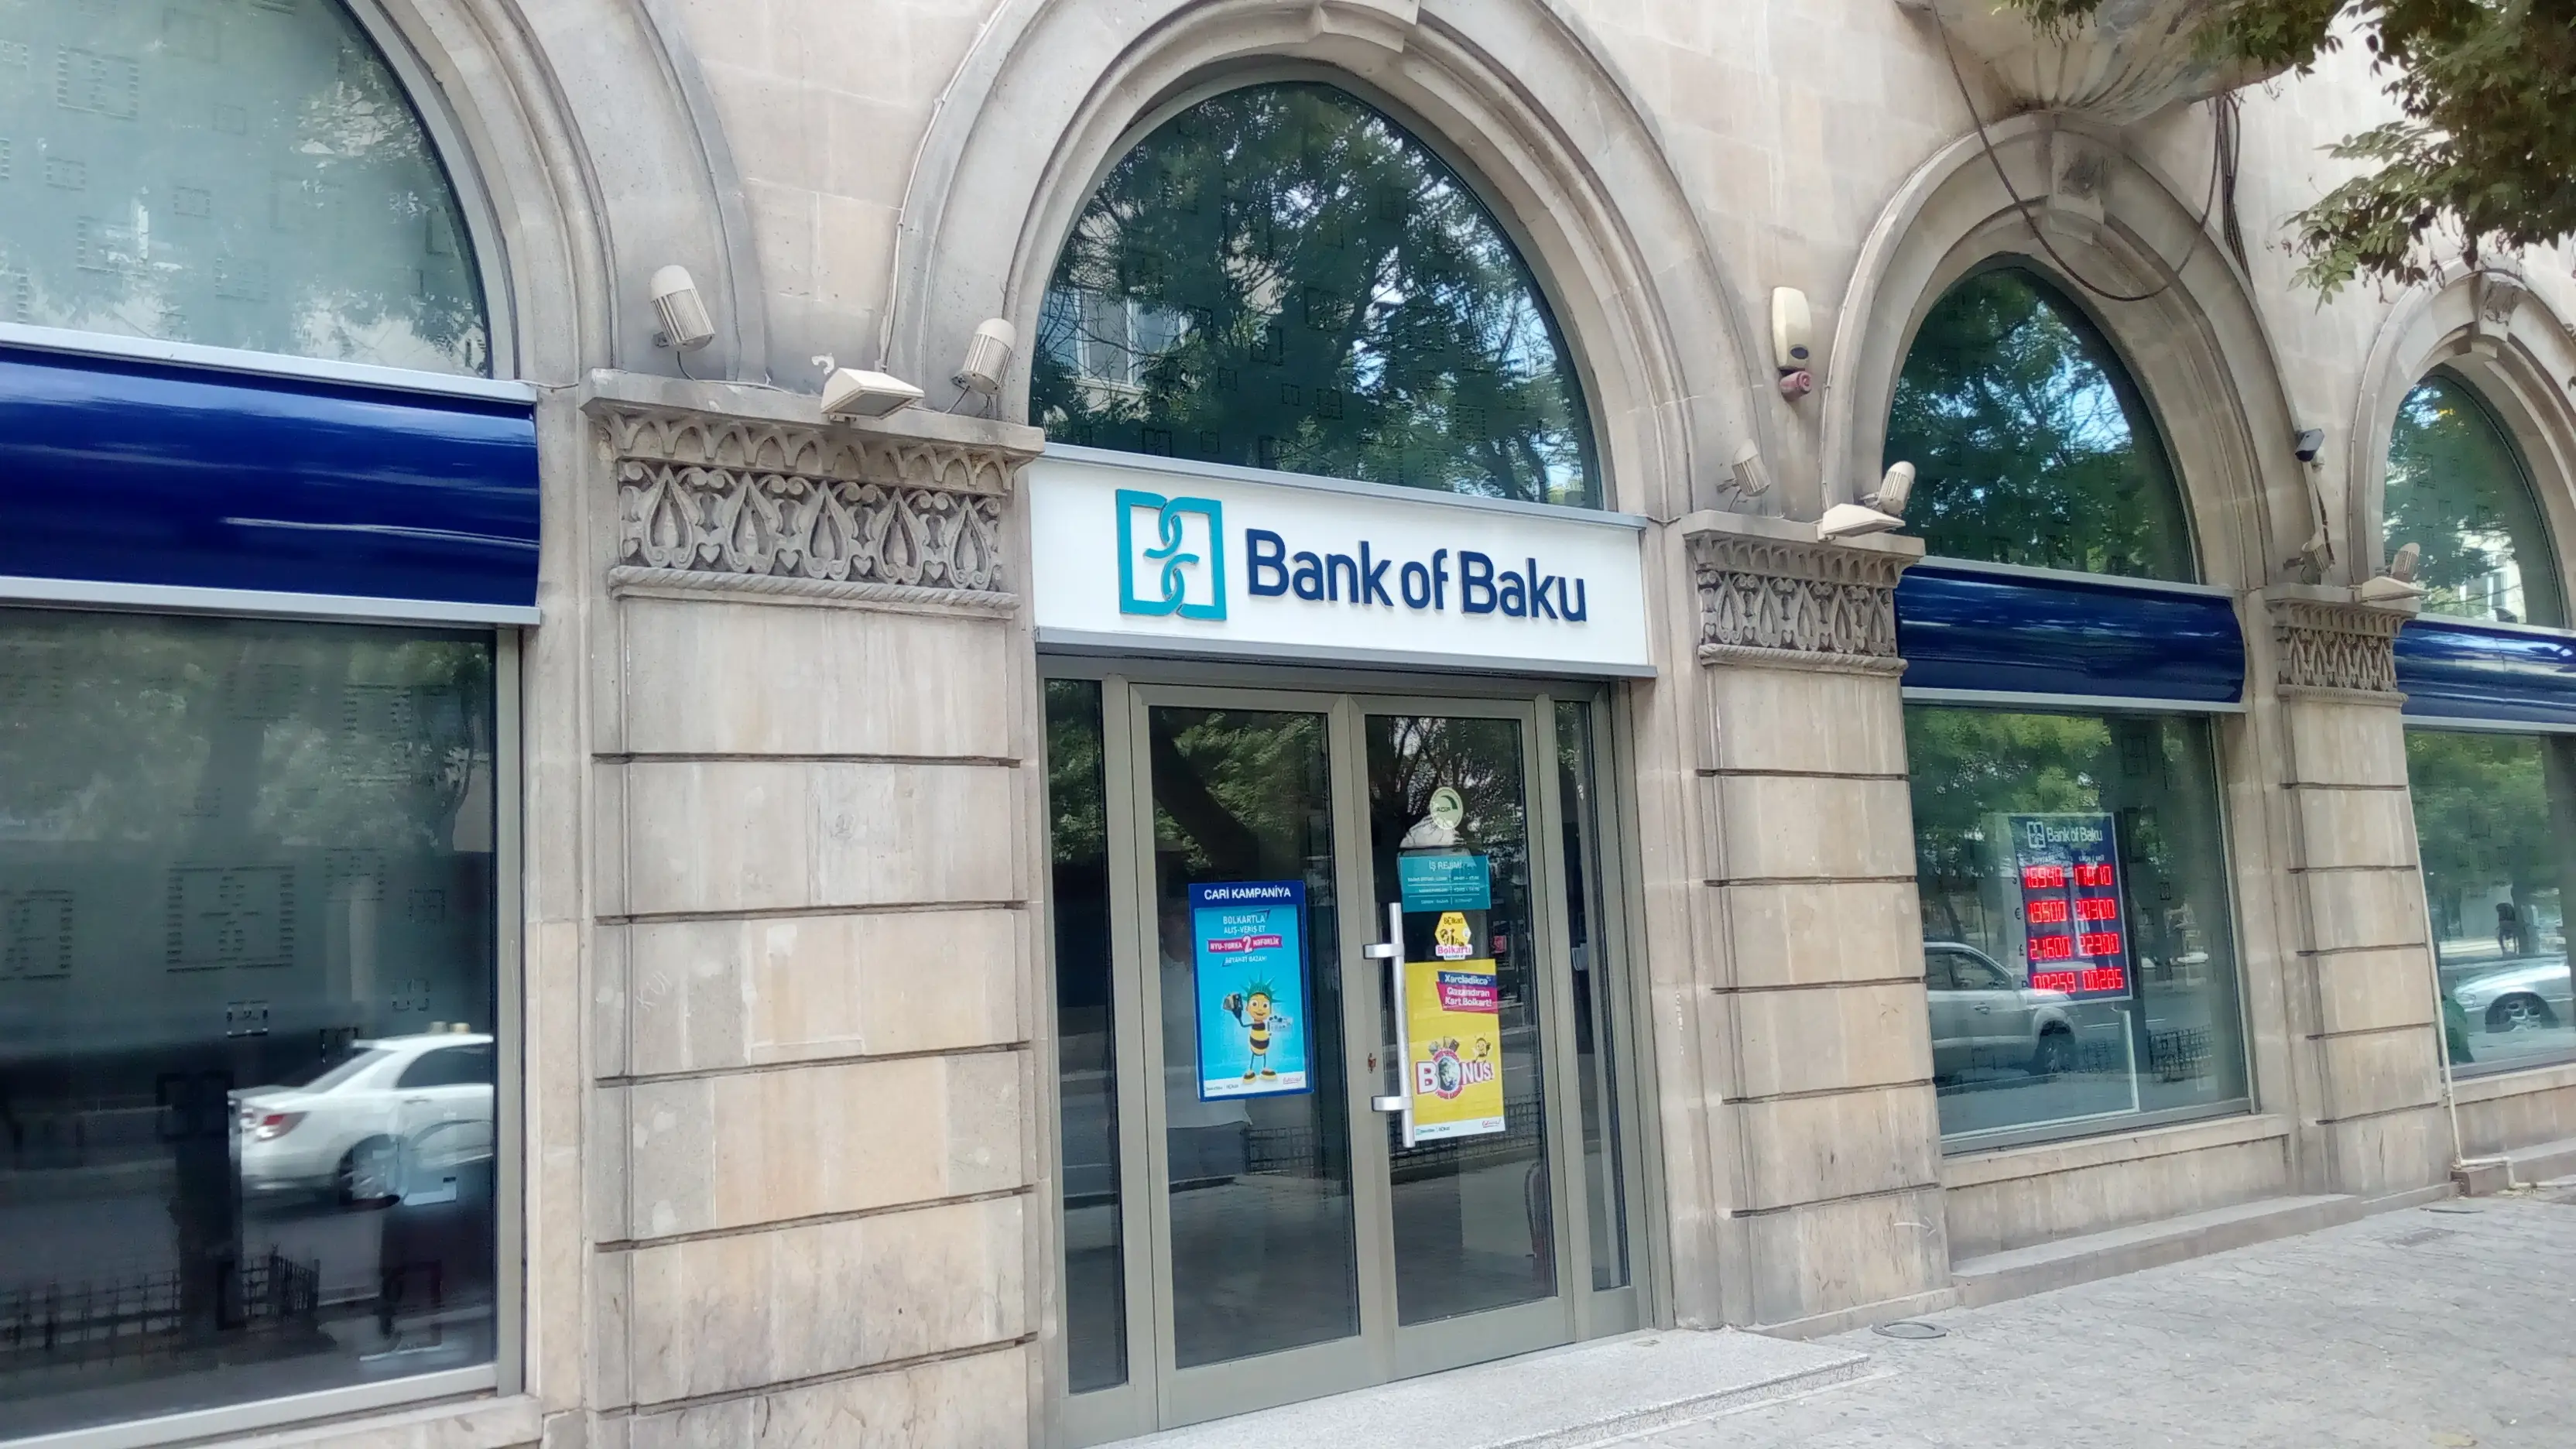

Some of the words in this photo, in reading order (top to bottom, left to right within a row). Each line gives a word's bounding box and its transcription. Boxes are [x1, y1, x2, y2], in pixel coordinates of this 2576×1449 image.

[1245, 528, 1394, 607] Bank
[1400, 549, 1449, 610] of
[1458, 550, 1587, 622] Baku
[2046, 826, 2071, 842] Bank
[2071, 827, 2080, 841] of
[2080, 826, 2103, 841] Baku
[1204, 887, 1229, 900] CARİ
[1231, 885, 1291, 899] KAMPANİYA
[1223, 915, 1266, 925] BOLKARTLA
[1242, 935, 1253, 954] 2
[1445, 995, 1461, 1006] Kart
